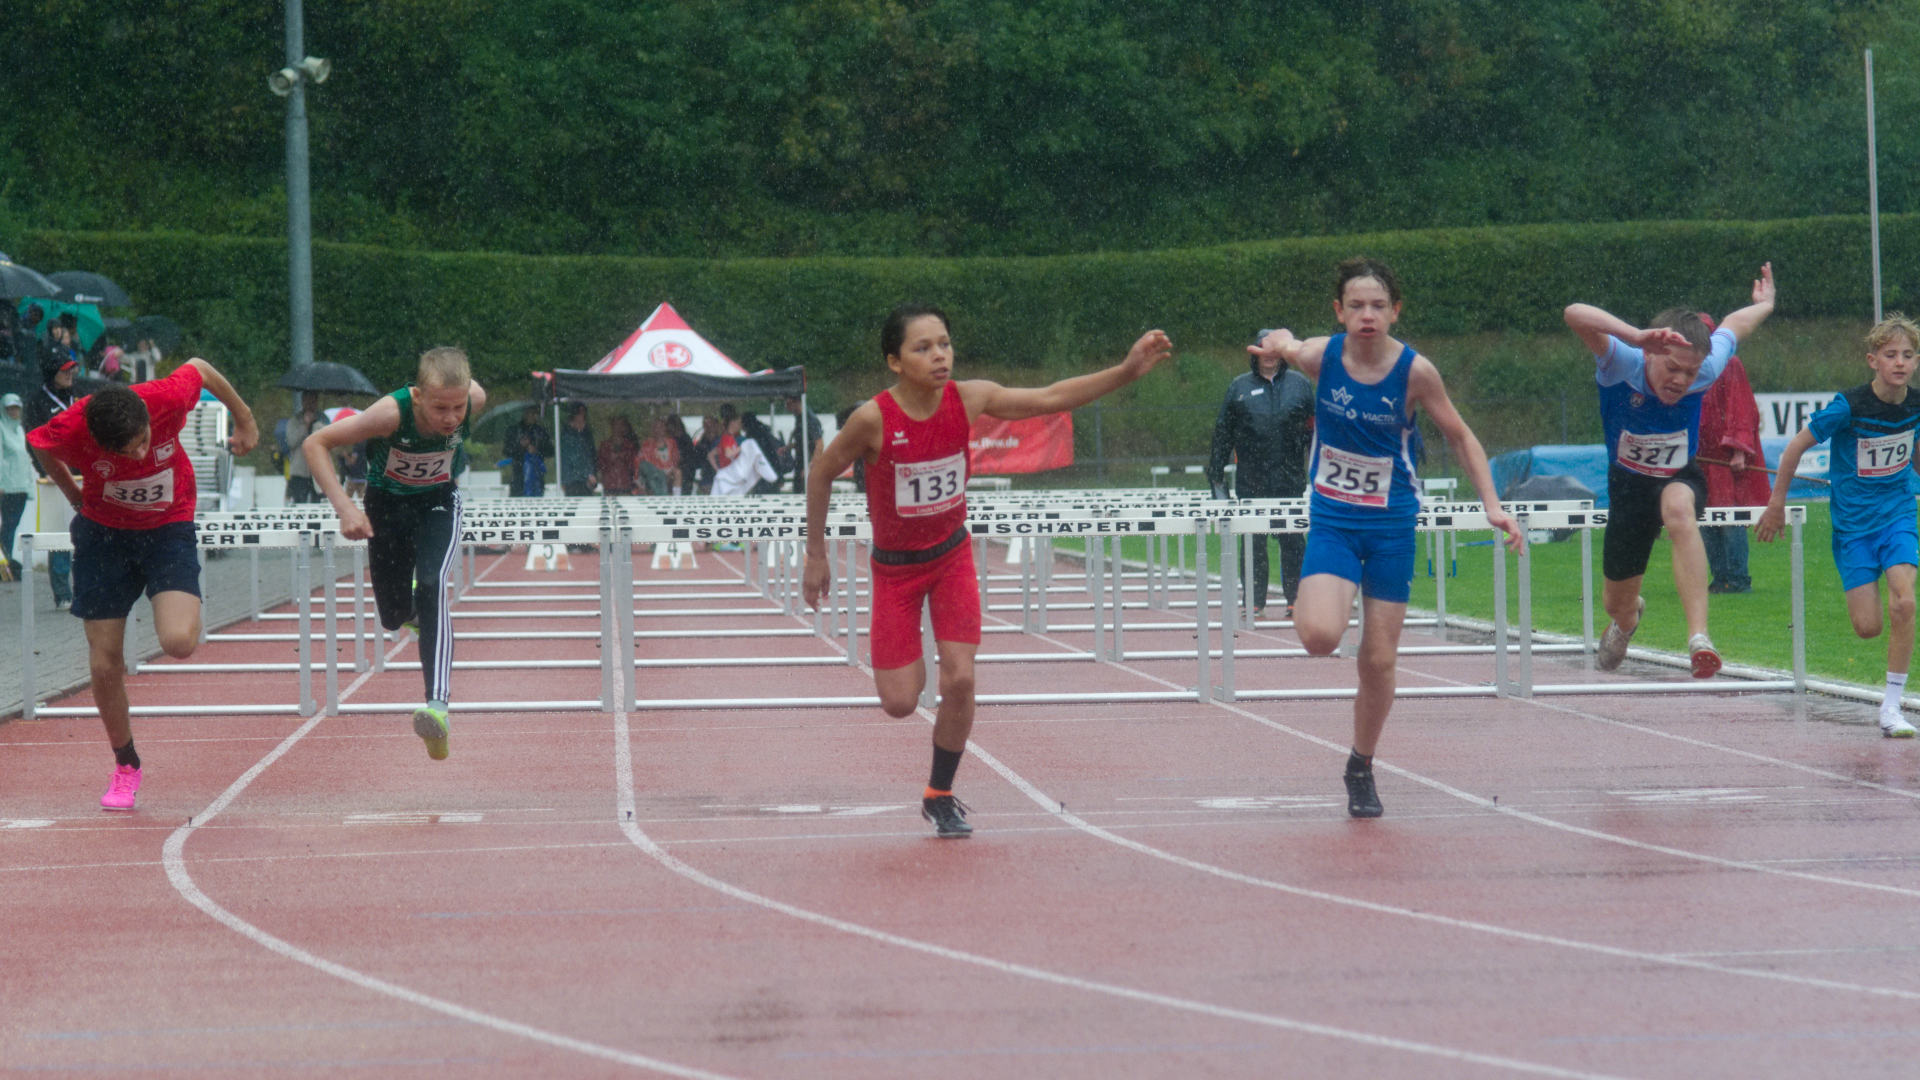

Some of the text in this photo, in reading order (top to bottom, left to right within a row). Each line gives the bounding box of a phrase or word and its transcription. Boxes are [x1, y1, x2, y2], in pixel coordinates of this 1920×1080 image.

[1626, 444, 1680, 466] 327
[1867, 443, 1908, 467] 179
[394, 460, 444, 478] 252
[1325, 461, 1380, 494] 255
[113, 484, 164, 503] 383
[908, 470, 957, 503] 133
[462, 531, 535, 542] ÄPER
[995, 521, 1132, 533] SCHÄPER
